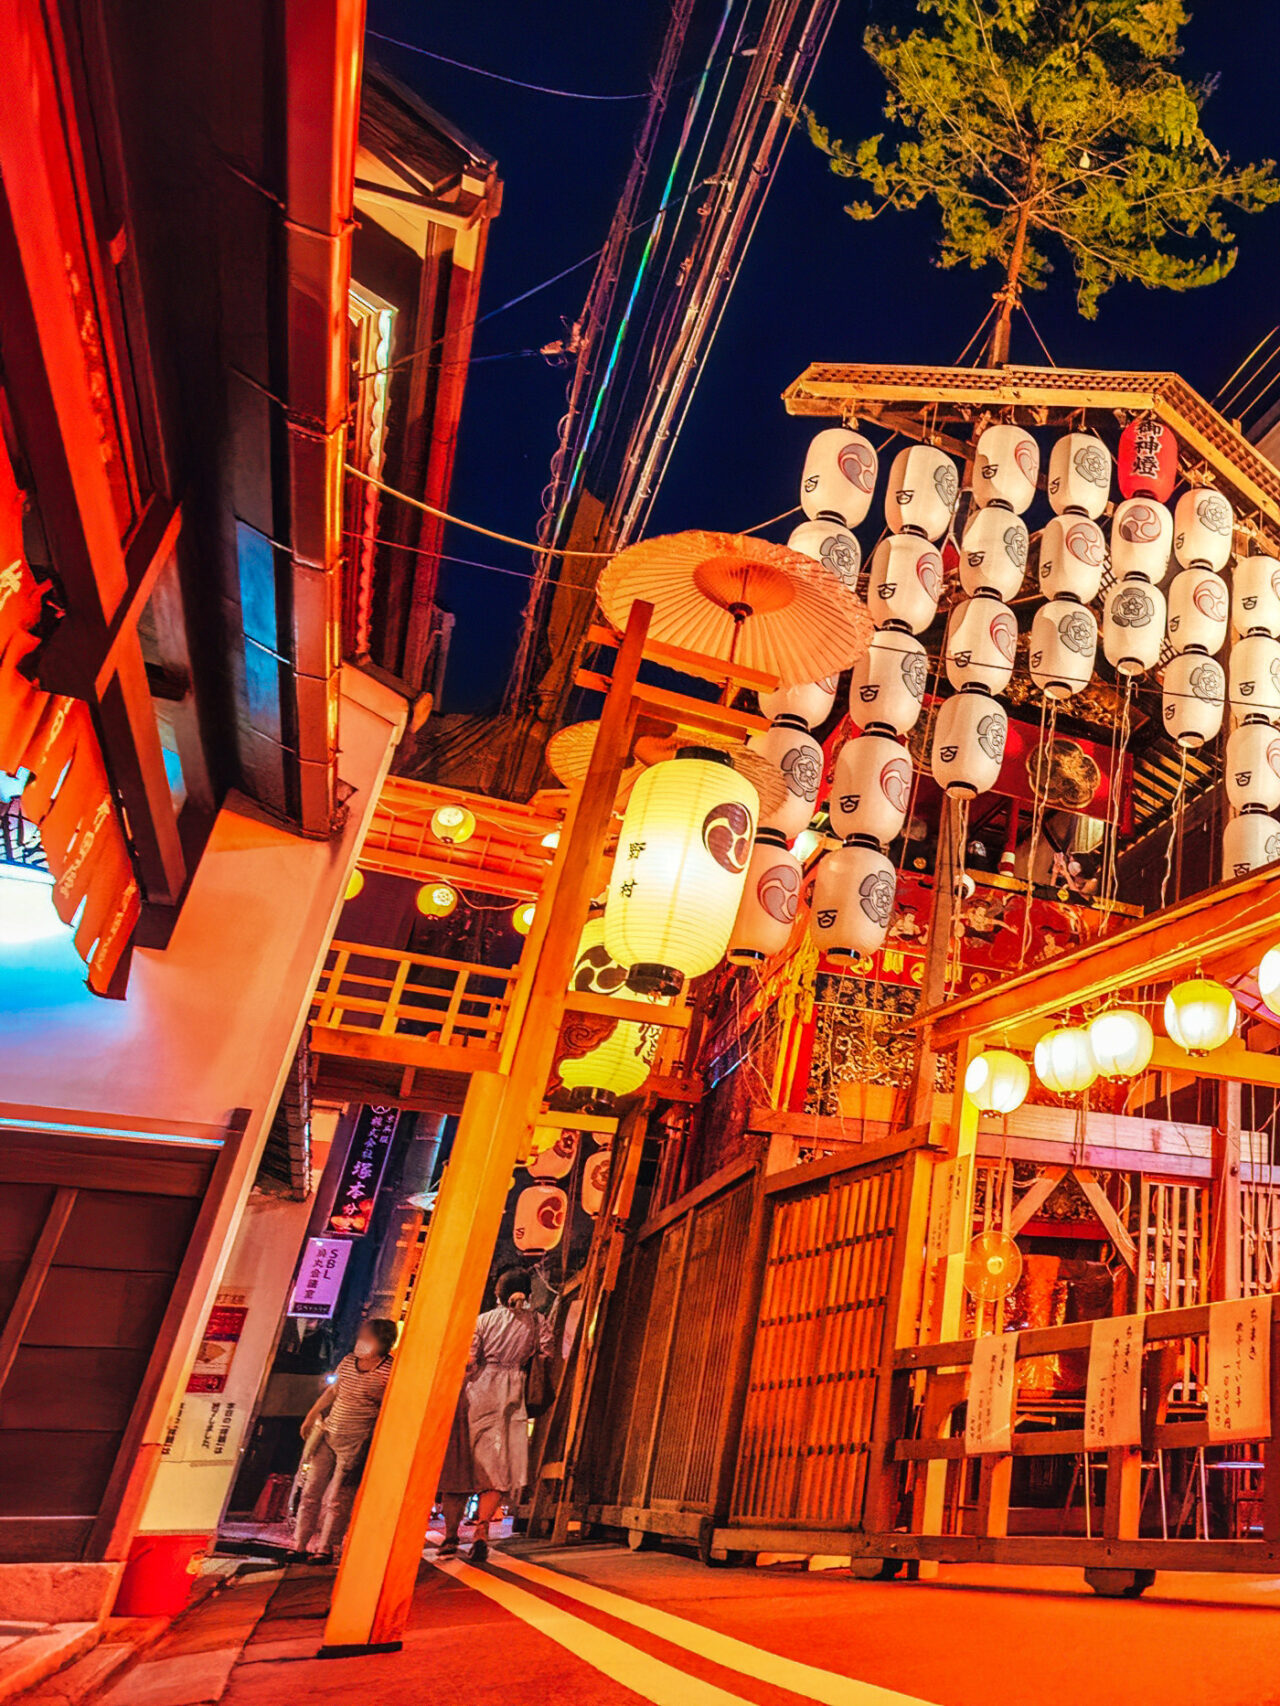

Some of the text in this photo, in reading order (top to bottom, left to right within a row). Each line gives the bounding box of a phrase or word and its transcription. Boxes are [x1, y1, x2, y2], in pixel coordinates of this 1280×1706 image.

[1132, 418, 1161, 477] 御神燈
[323, 1249, 339, 1280] SBL
